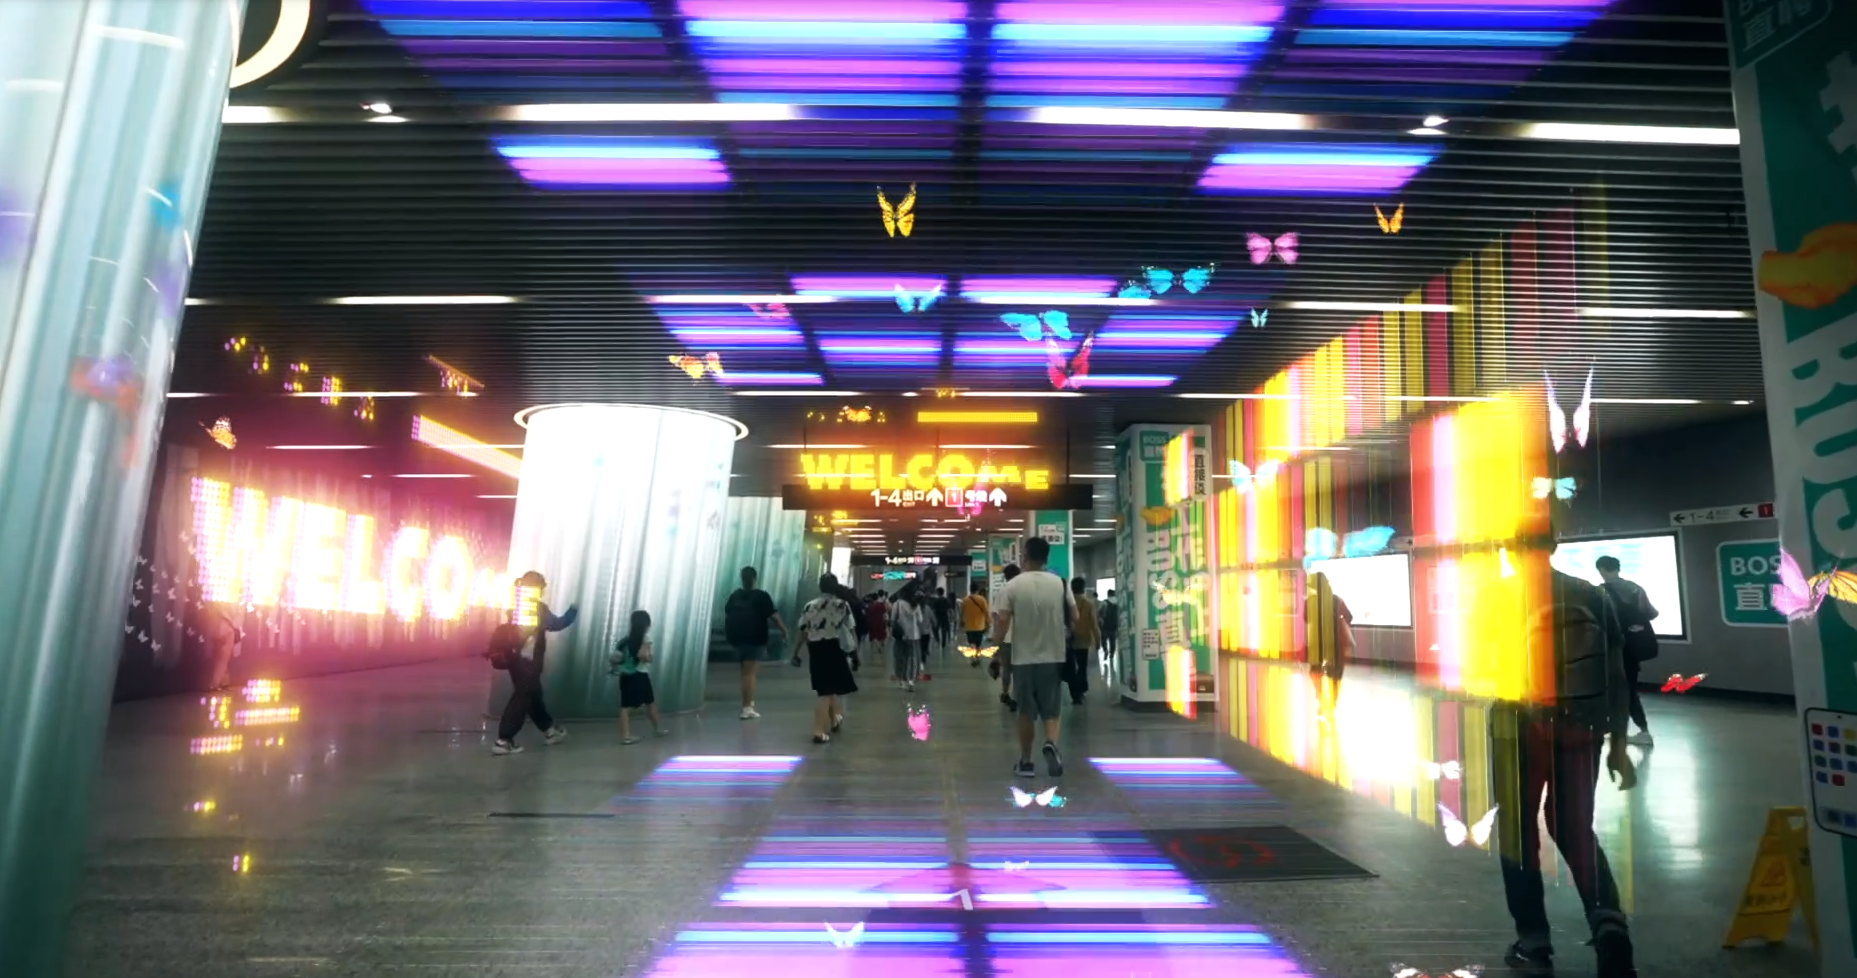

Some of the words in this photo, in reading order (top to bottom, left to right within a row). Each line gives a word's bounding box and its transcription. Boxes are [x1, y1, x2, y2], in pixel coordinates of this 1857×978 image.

[801, 453, 1049, 491] WELCOME
[871, 488, 902, 507] 1-4
[903, 489, 925, 501] 出口
[1689, 510, 1715, 522] 1-4
[1730, 555, 1782, 576] BOS
